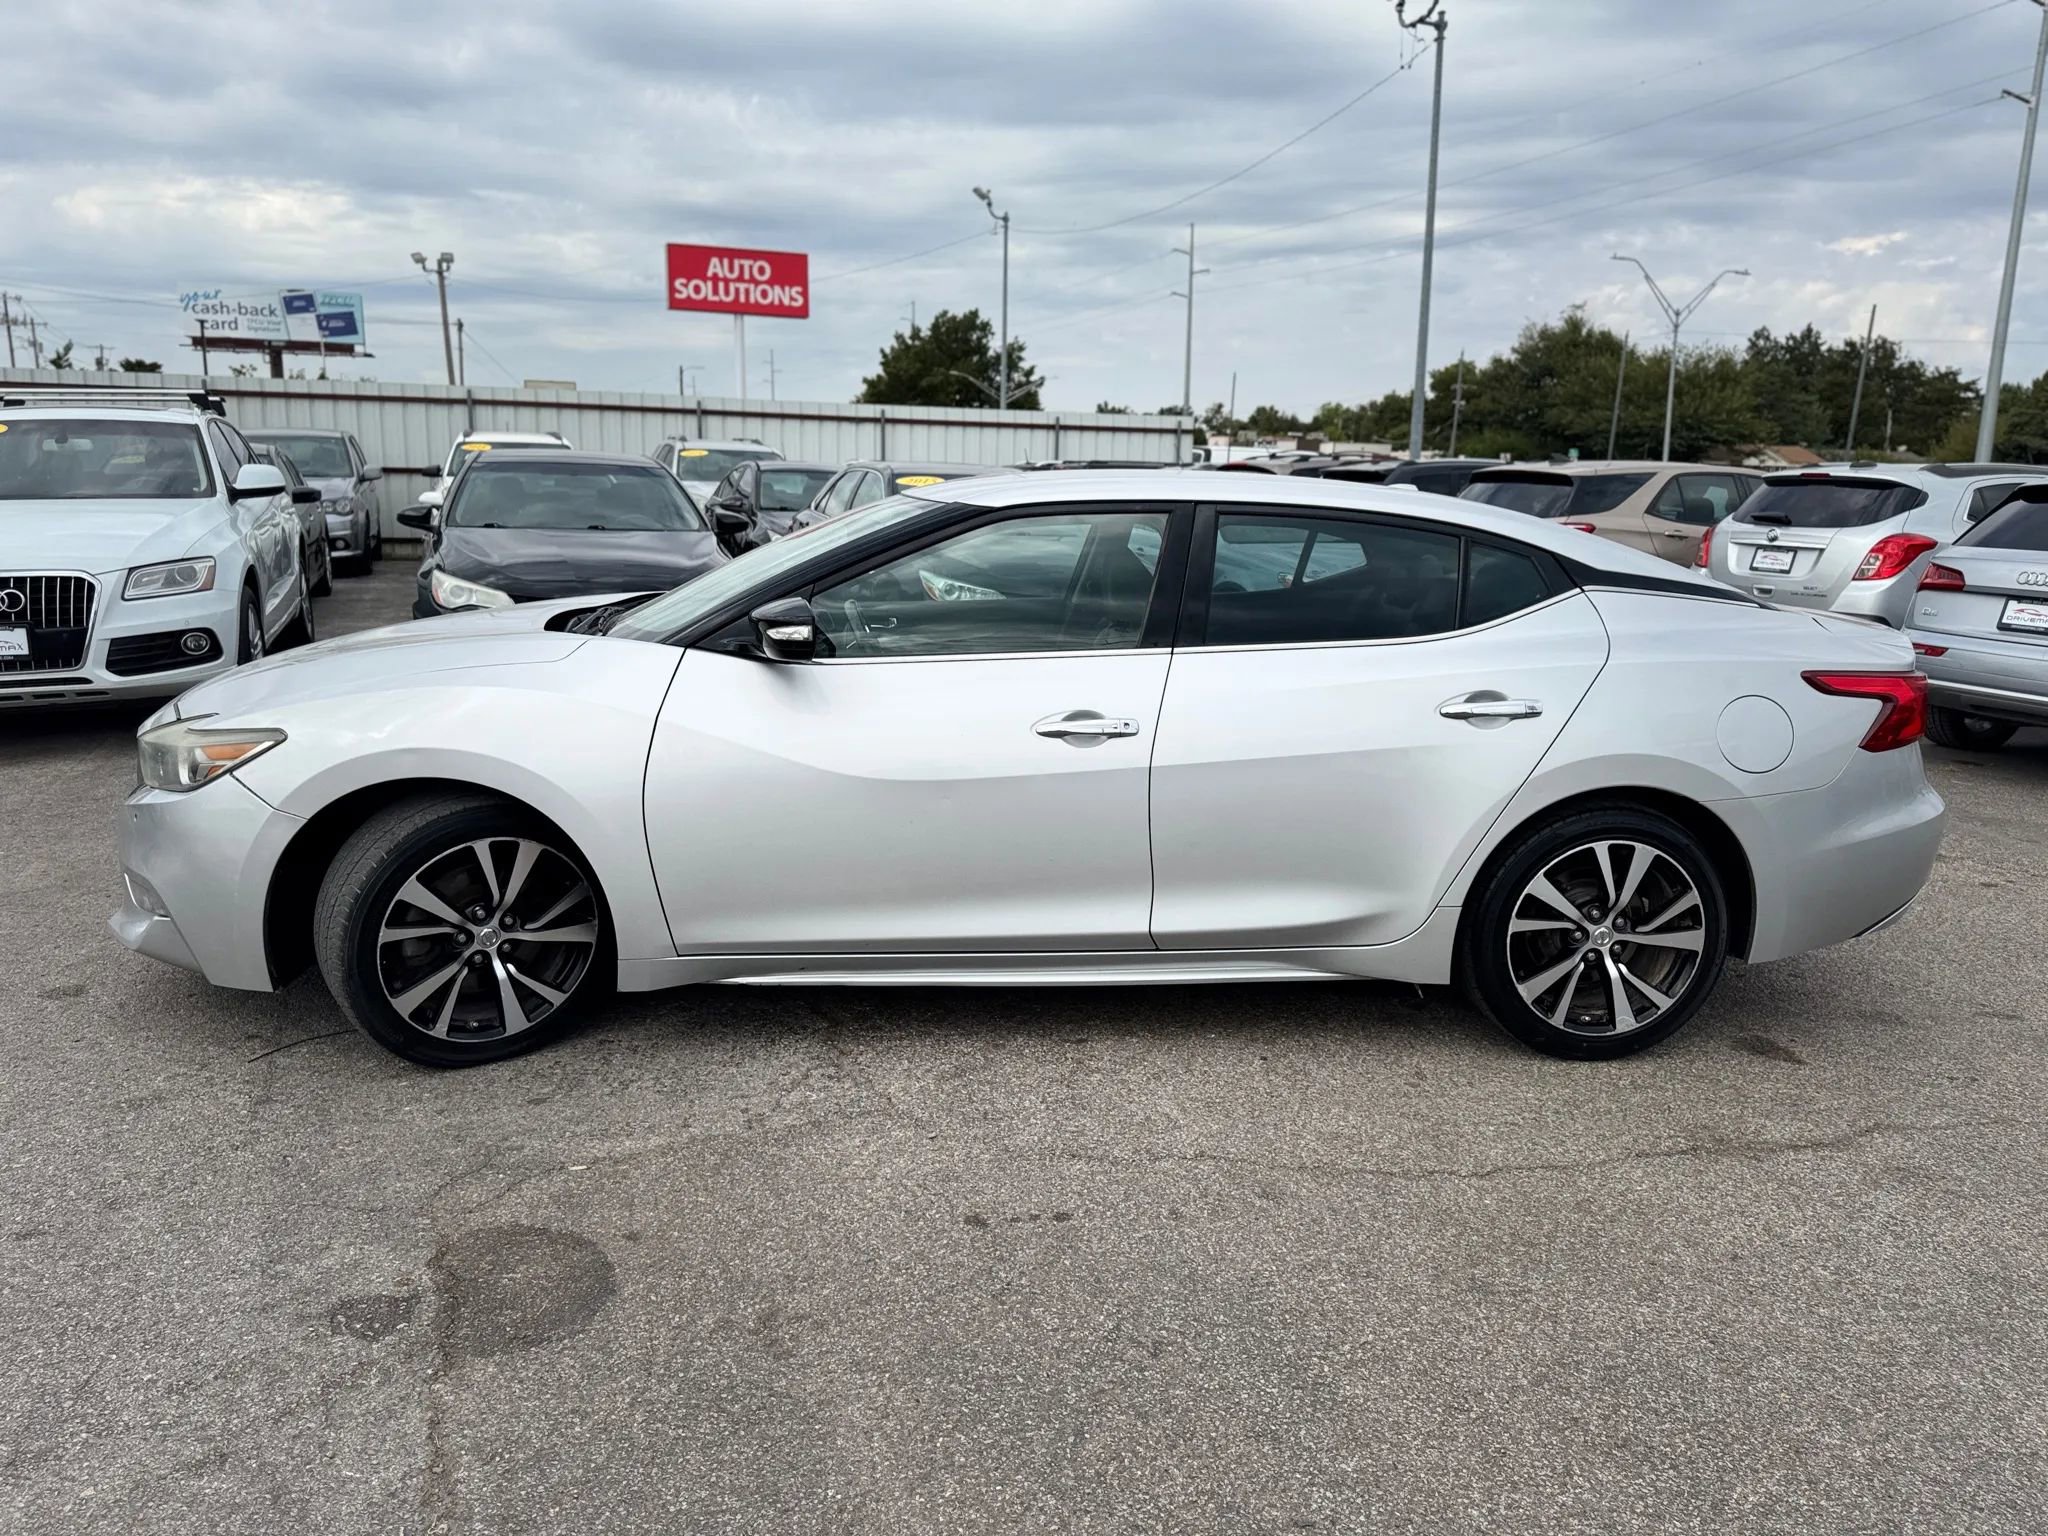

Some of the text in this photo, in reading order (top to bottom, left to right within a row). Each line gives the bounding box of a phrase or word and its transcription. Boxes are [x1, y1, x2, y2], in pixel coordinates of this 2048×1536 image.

[707, 256, 772, 281] AUTO
[179, 289, 222, 312] your
[673, 277, 804, 307] SOLUTIONS
[191, 300, 279, 318] cash-back
[201, 317, 239, 331] card
